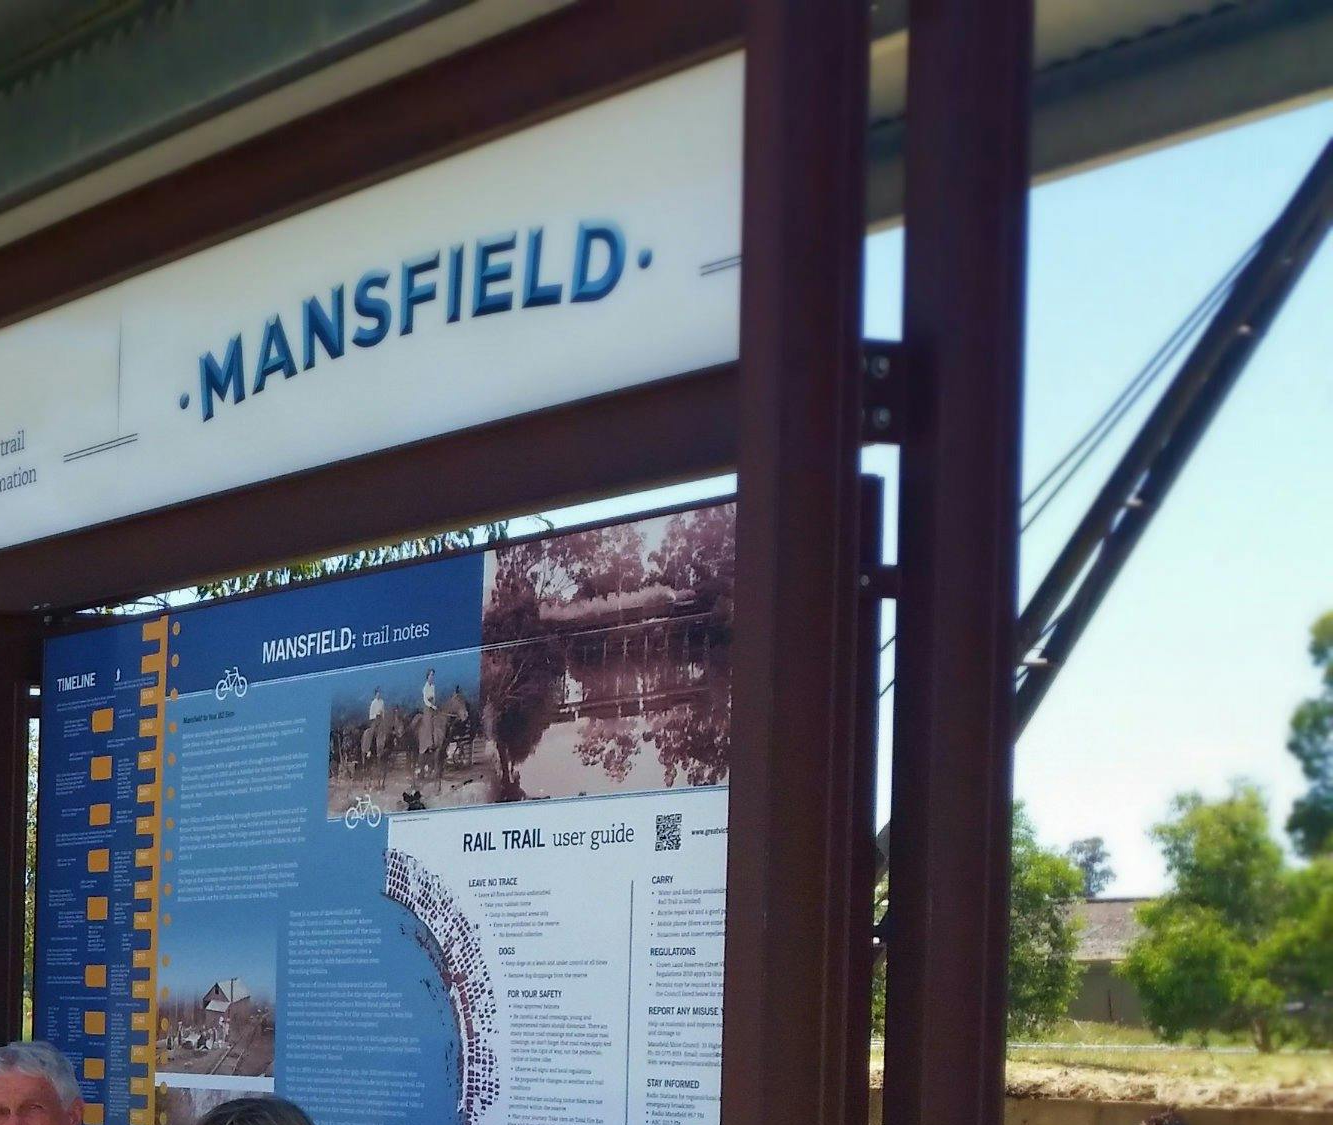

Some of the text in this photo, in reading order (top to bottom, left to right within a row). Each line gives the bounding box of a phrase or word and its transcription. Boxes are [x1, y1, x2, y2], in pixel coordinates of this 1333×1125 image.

[0, 430, 25, 457] trail
[262, 623, 430, 664] MANSFIELD: trail notes
[57, 673, 96, 693] TIMELINE
[463, 823, 633, 852] RAIL TRAIL user guide
[468, 877, 518, 888] LEAVE NO TRACE
[651, 875, 674, 885] CARRY
[498, 947, 515, 956] DOGS
[650, 947, 696, 956] REGULATIONS
[507, 989, 563, 999] FOR YOUR SAFETY
[648, 1006, 719, 1016] REPORT ANY MISUSE
[647, 1078, 700, 1089] STAY INFORMED
